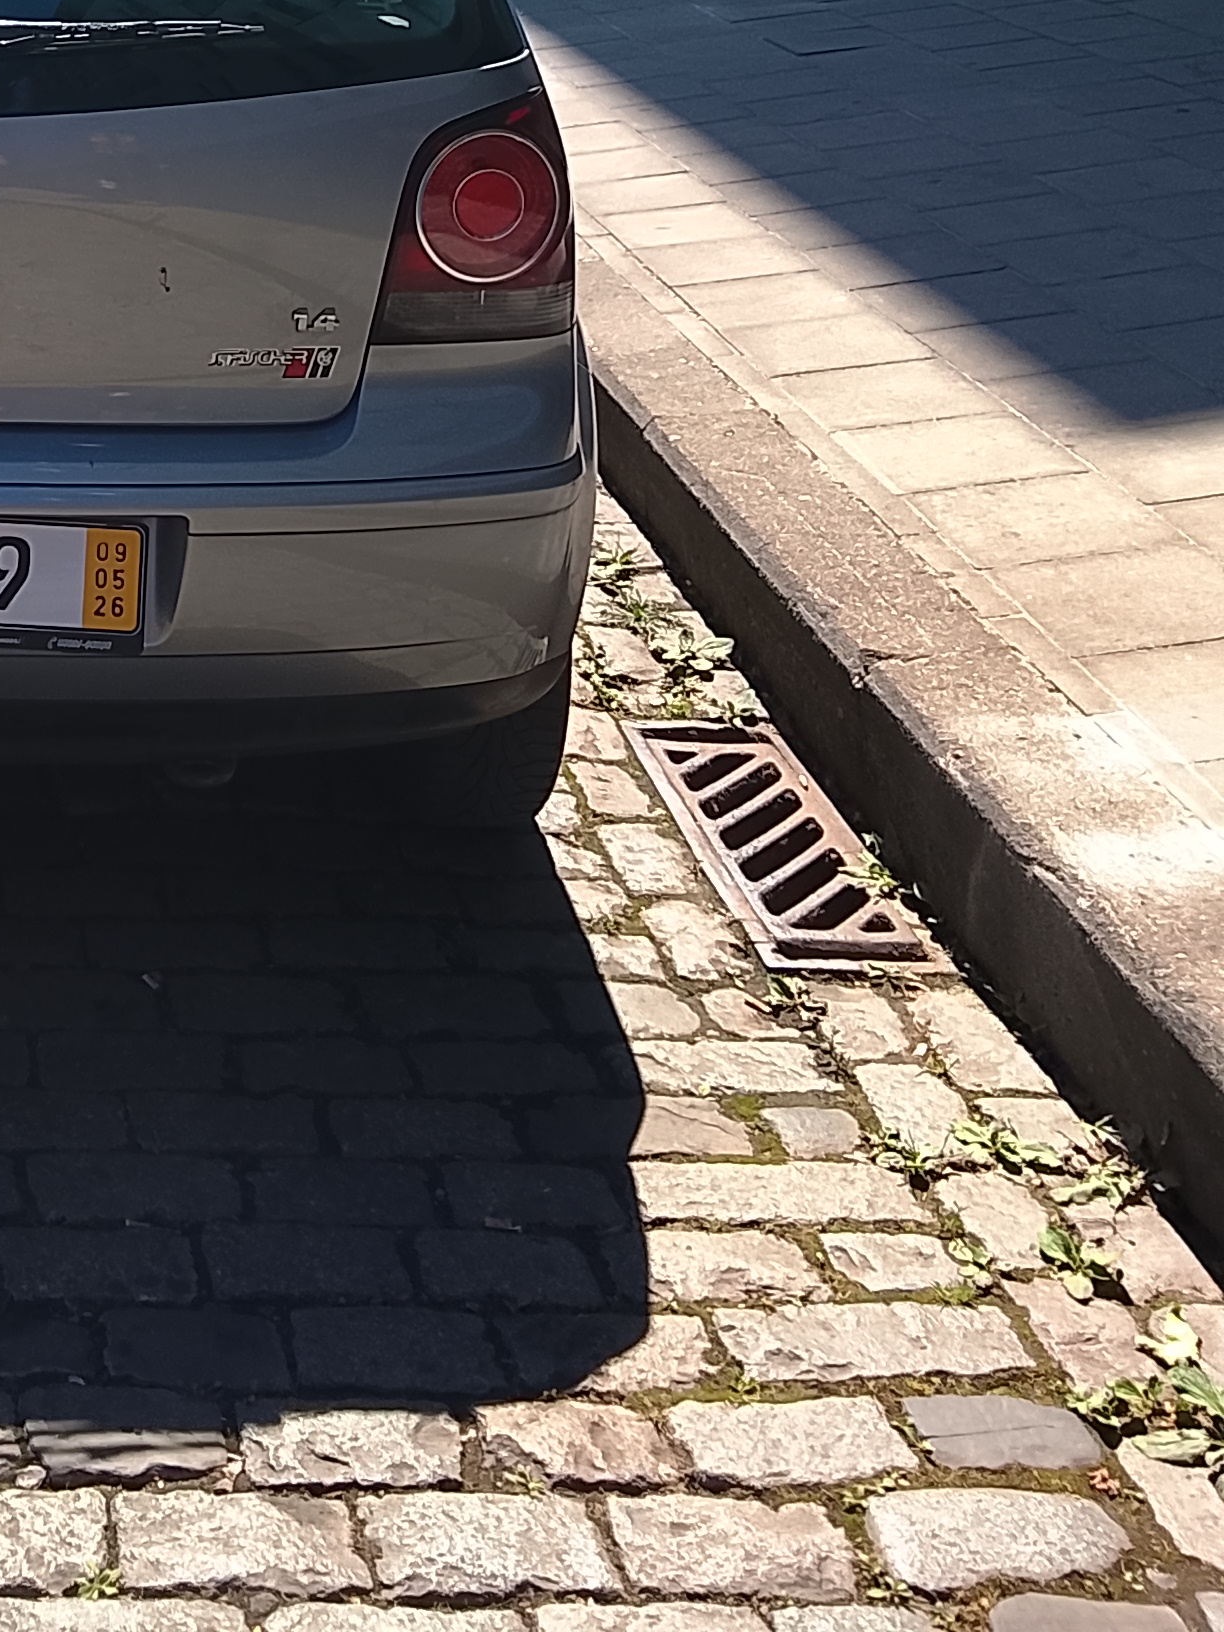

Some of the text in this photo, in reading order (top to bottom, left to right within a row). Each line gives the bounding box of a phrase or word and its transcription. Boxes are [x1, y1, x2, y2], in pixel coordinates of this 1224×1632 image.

[96, 542, 127, 563] 09
[95, 568, 125, 590] 05
[93, 595, 124, 617] 26
